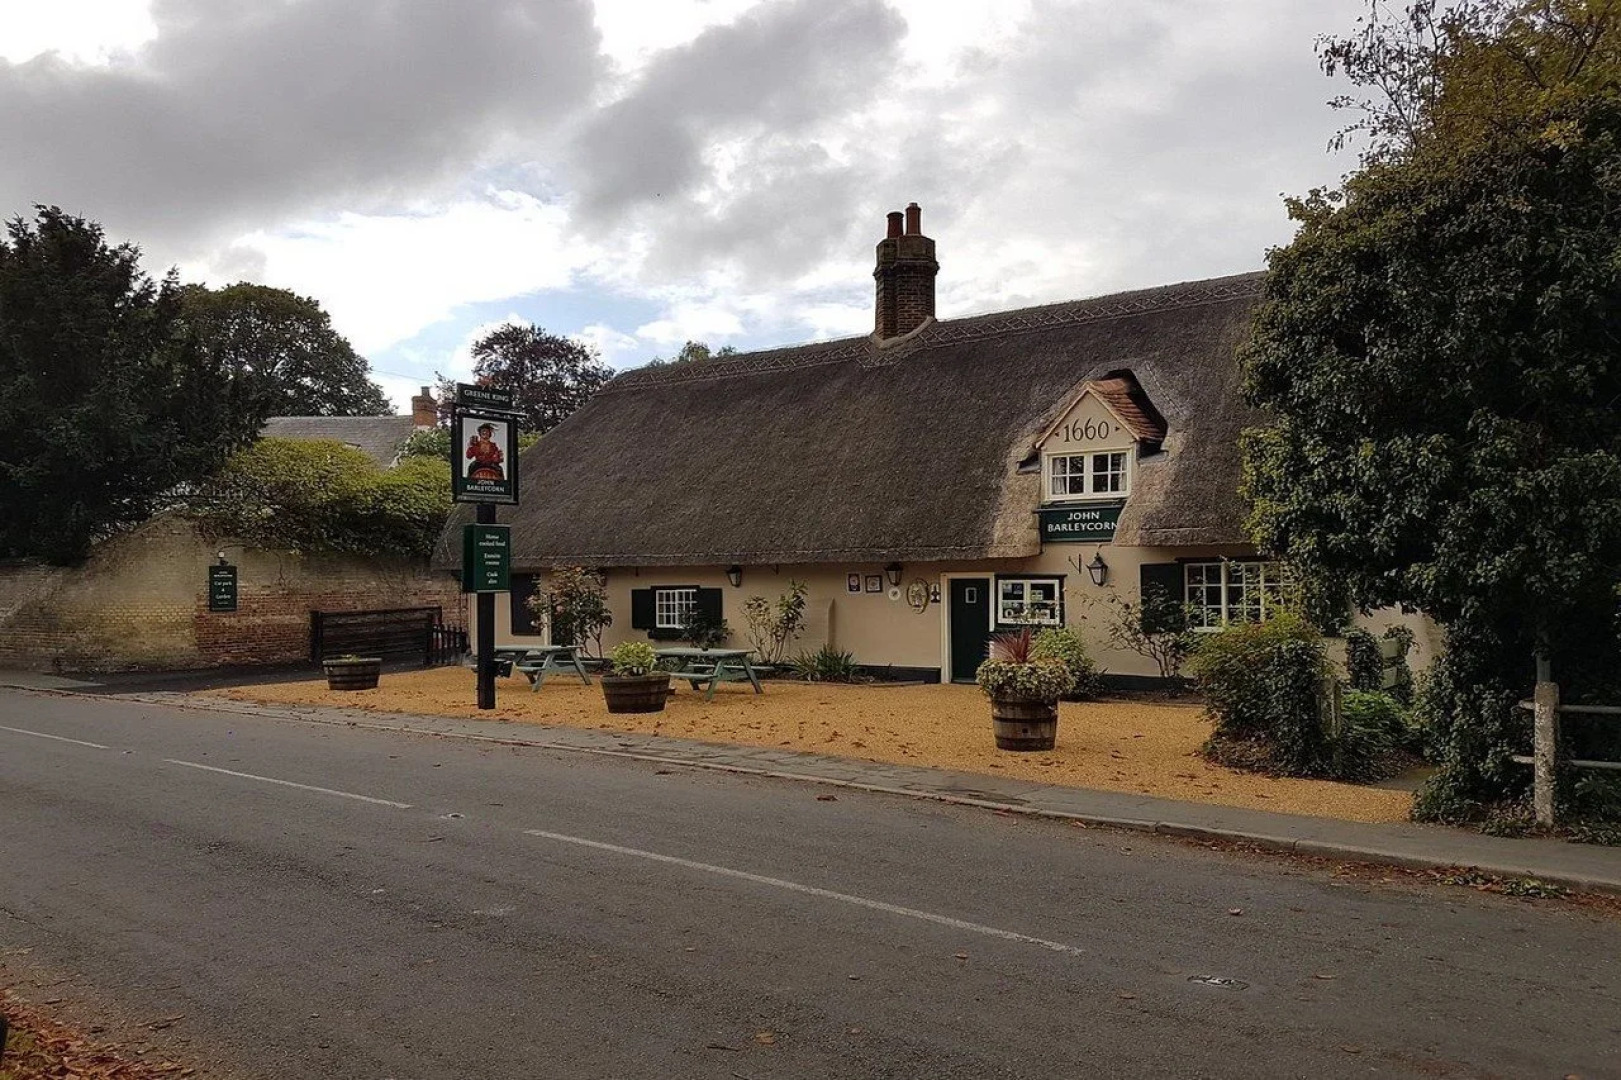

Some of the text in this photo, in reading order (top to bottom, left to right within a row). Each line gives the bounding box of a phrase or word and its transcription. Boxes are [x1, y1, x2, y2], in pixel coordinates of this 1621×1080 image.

[464, 389, 490, 400] GREENE
[492, 393, 510, 402] KING
[1063, 418, 1109, 443] 1660
[466, 485, 505, 493] BARLEYCORN
[1067, 510, 1100, 521] JOHN
[1047, 521, 1118, 533] BARLEYCORN
